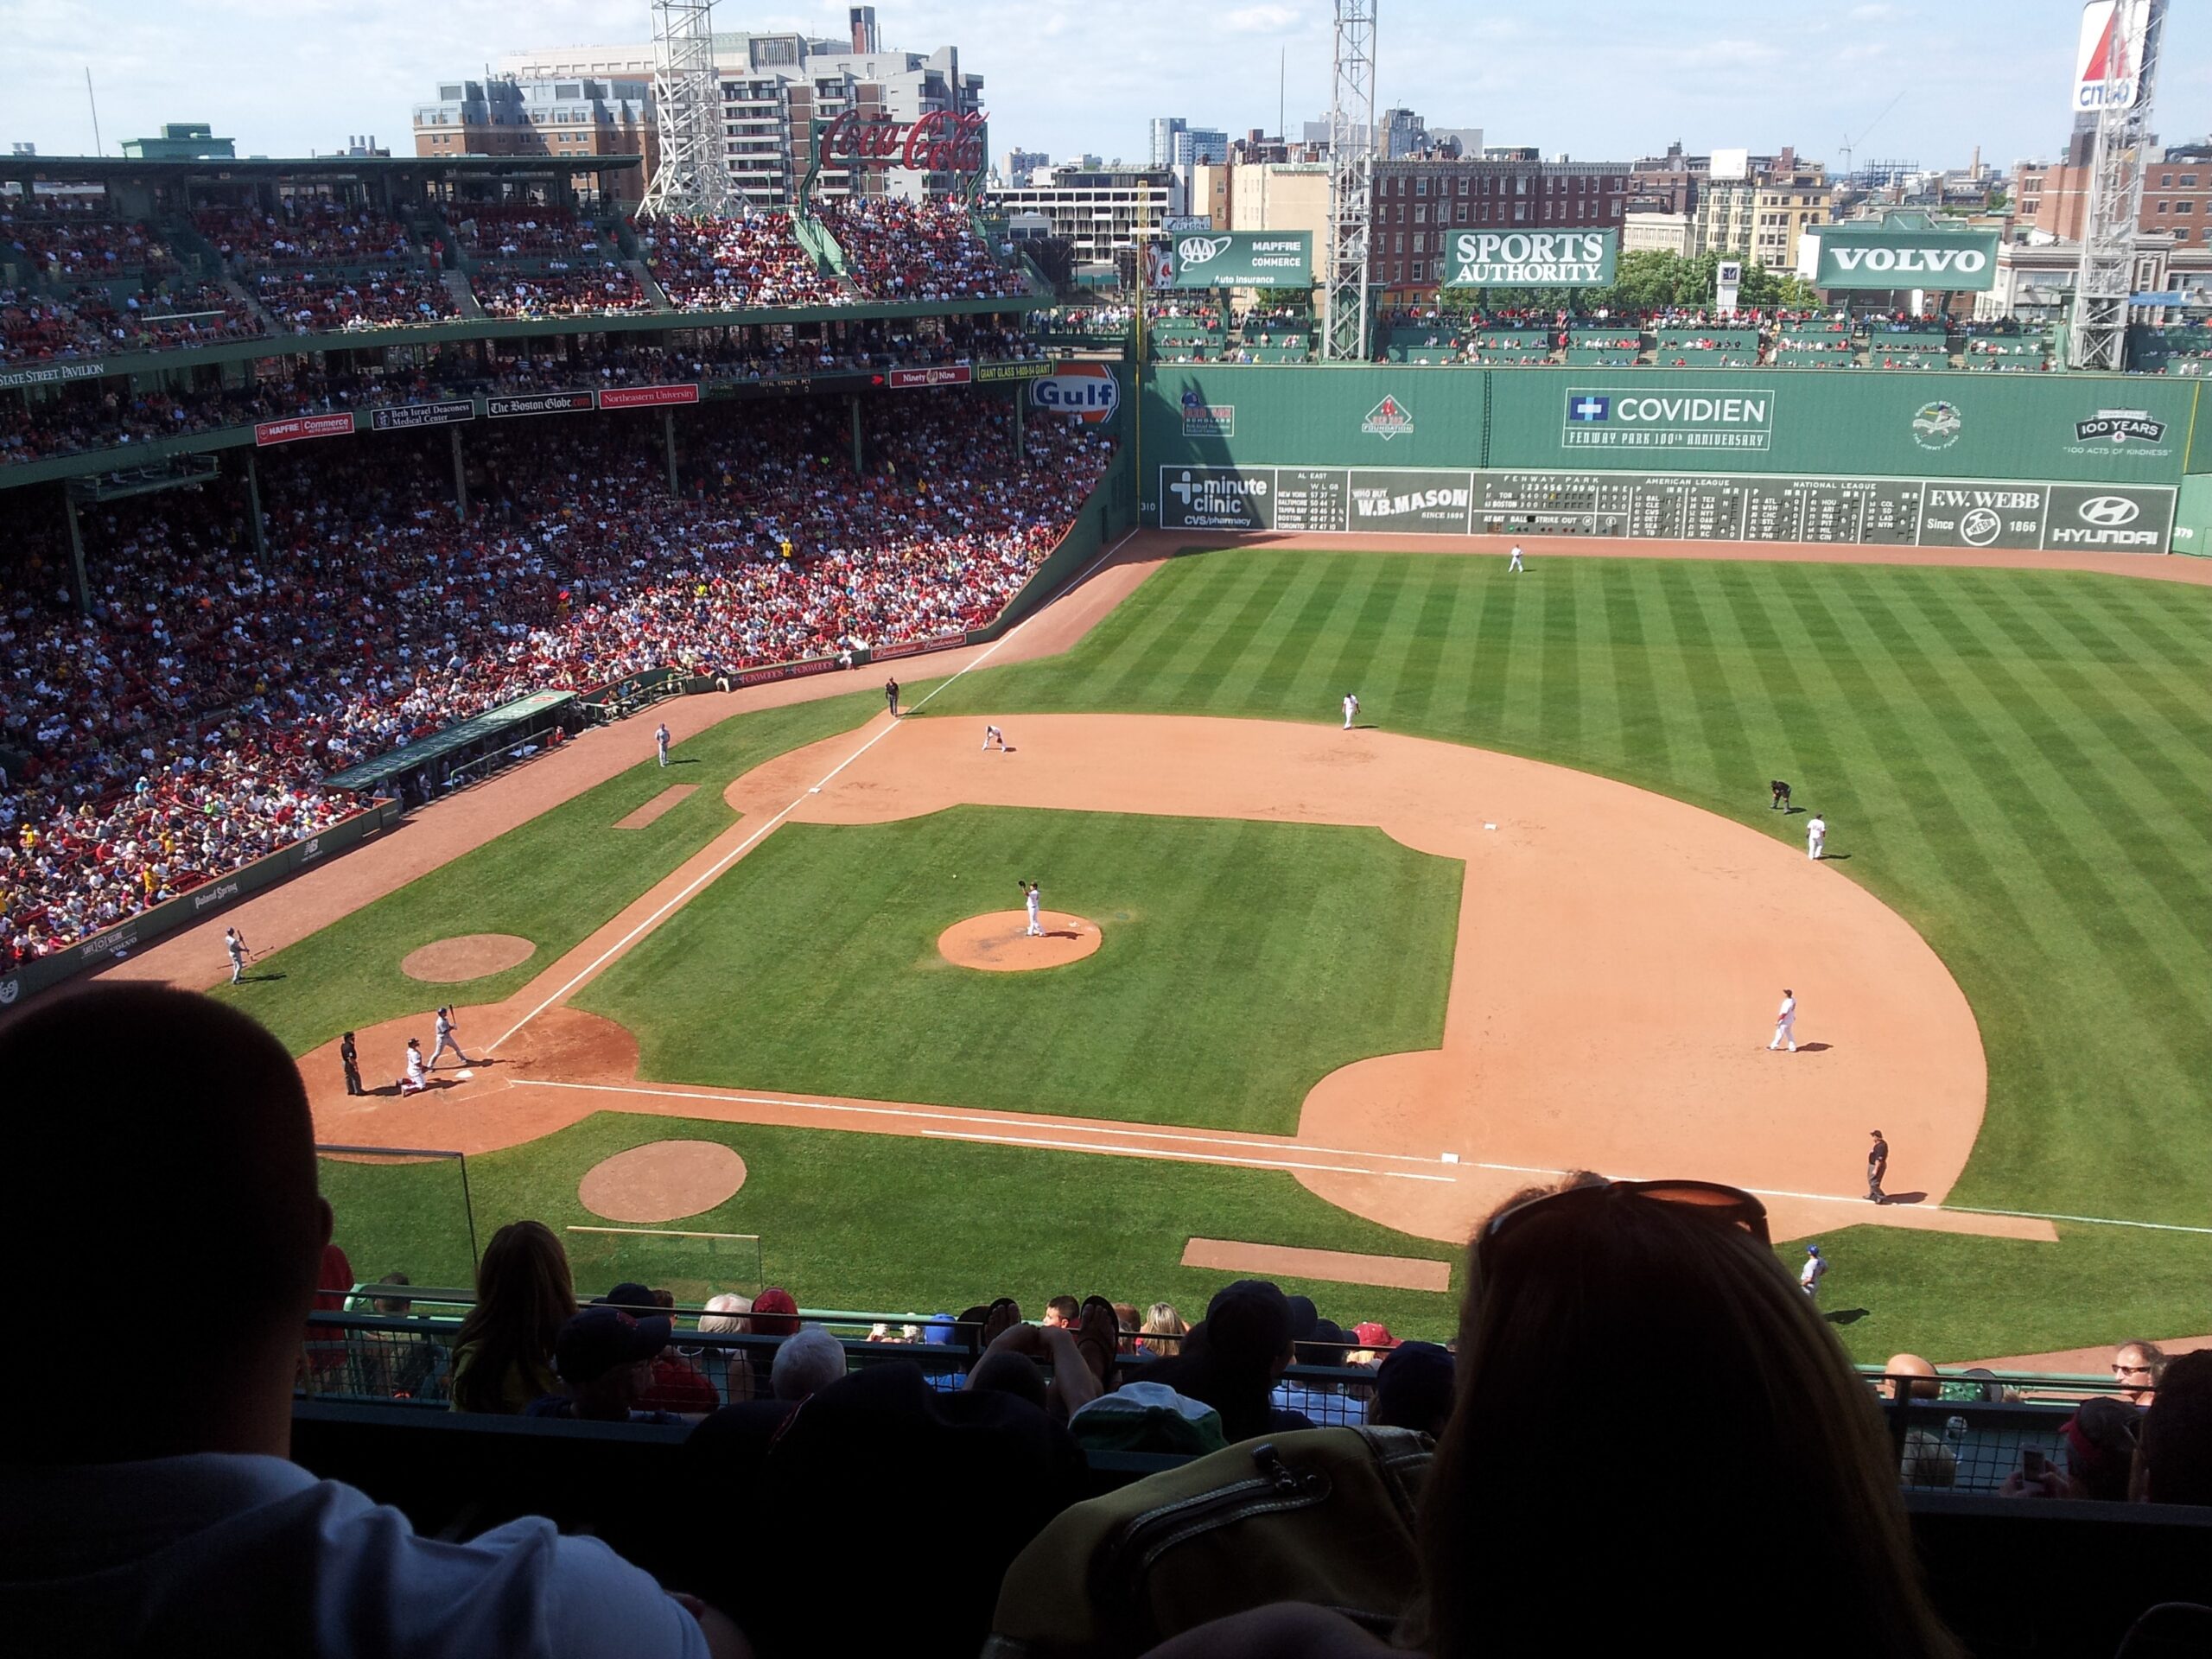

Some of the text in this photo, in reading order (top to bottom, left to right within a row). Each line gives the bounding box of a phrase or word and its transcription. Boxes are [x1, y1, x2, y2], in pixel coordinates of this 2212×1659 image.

[1184, 240, 1211, 261] AAA
[1253, 241, 1301, 251] MAPFRE
[1457, 233, 1603, 264] SPORTS
[1252, 257, 1300, 267] COMMERCE
[1829, 248, 1986, 272] VOLVO
[1215, 275, 1274, 284] Auto Insurance
[26, 369, 59, 383] STREET
[61, 364, 104, 378] PAVILION
[903, 371, 956, 382] Ninety Nine
[981, 368, 996, 378] GIANT
[997, 367, 1015, 378] GLASS
[1035, 363, 1051, 374] GIANT
[605, 393, 654, 404] Northeastern
[656, 390, 696, 402] University
[1037, 381, 1113, 406] Gulf
[391, 404, 470, 418] Beth Israel Deaconess
[491, 402, 509, 414] The
[511, 399, 543, 411] Boston
[1618, 398, 1765, 422] COVIDIEN
[1915, 401, 1937, 417] BOSTON
[269, 418, 349, 435] MAPFRE Commerce
[393, 414, 448, 427] Medical Center
[2082, 420, 2158, 436] 100 YEARS
[1569, 431, 1616, 444] FENWAY
[1621, 433, 1649, 445] PARK
[1687, 434, 1764, 447] ANNIVERSARY
[1204, 475, 1267, 495] minute
[1352, 488, 1388, 499] WHO BUT
[1974, 492, 2040, 509] WEBB
[1141, 502, 1156, 512] 310
[1193, 494, 1241, 513] clinic
[1184, 515, 1251, 526] CVS/pharmacy
[1927, 518, 2037, 532] Since 1866
[2053, 529, 2158, 544] HYUNDAI
[2174, 528, 2193, 538] 379
[741, 660, 835, 683] FOXWOODS FOXWOODS
[195, 883, 238, 909] Poland Spring
[109, 936, 137, 953] VOLVO
